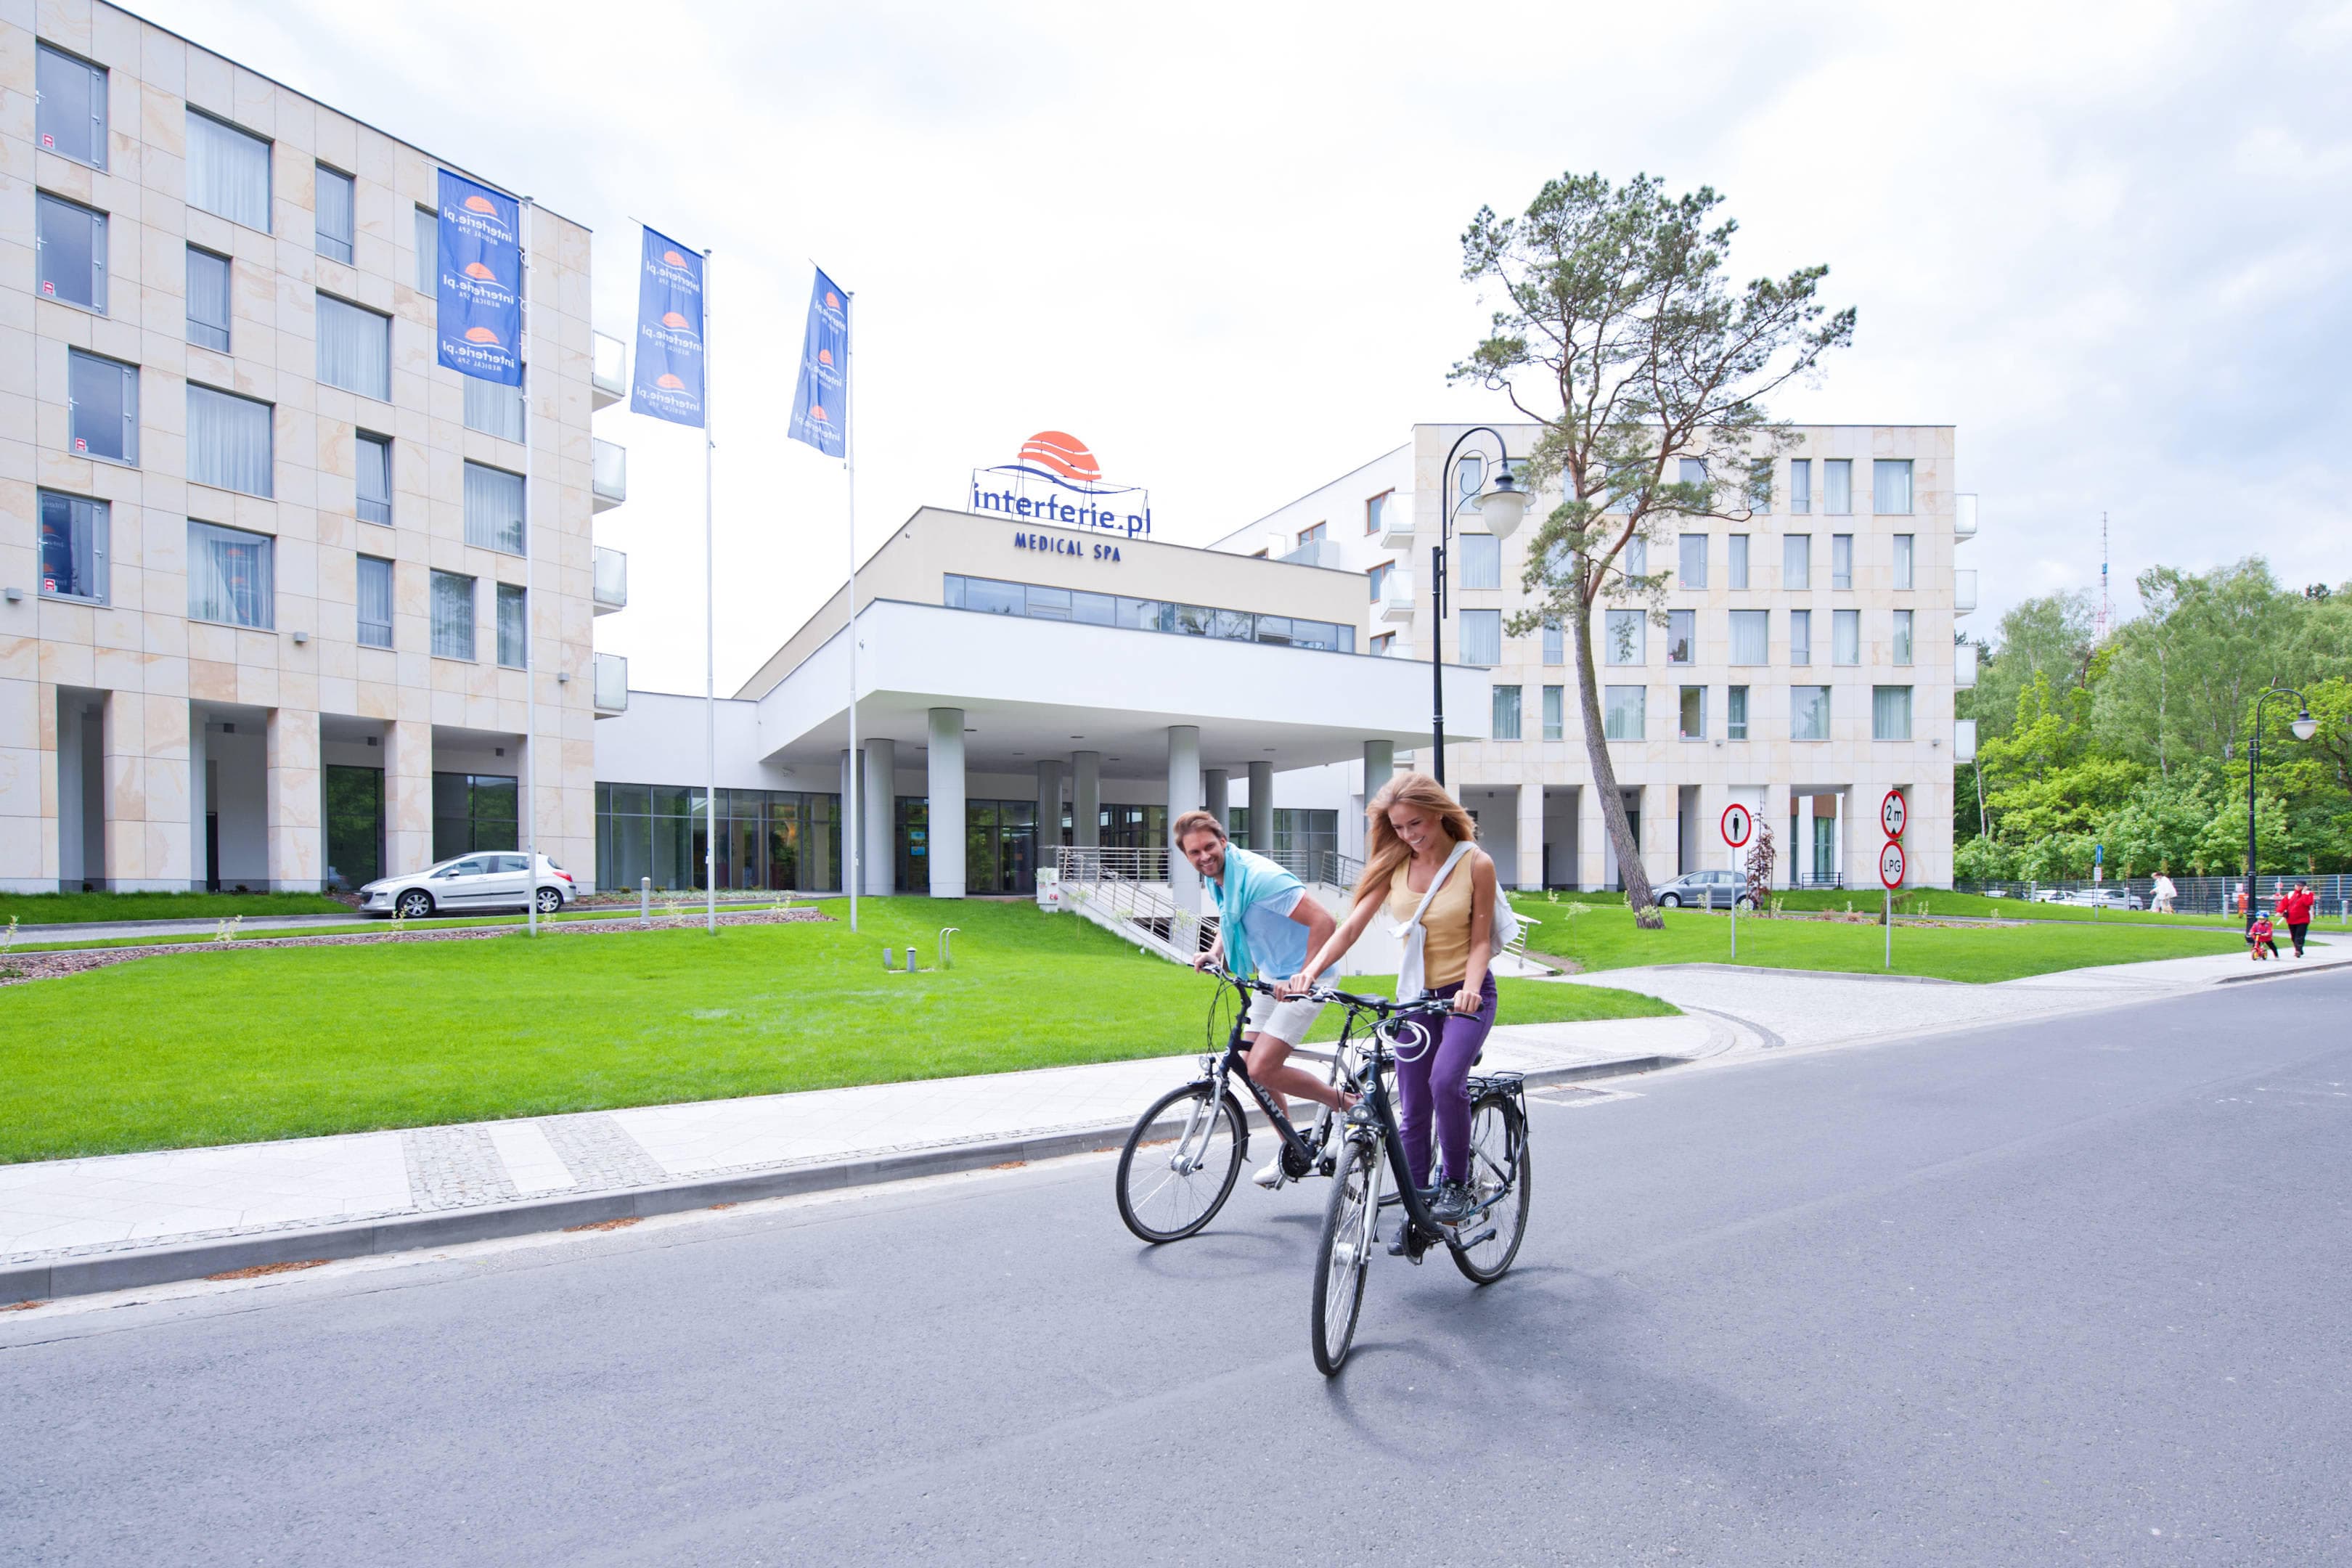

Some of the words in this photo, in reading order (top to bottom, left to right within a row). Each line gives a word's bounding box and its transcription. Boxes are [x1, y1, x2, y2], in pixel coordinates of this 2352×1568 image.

[973, 483, 1151, 538] interferie.pl
[1014, 532, 1084, 556] MEDICAL
[1093, 544, 1121, 562] SPA
[1886, 804, 1892, 821] 2
[1894, 810, 1902, 822] m
[1884, 859, 1901, 873] LPG
